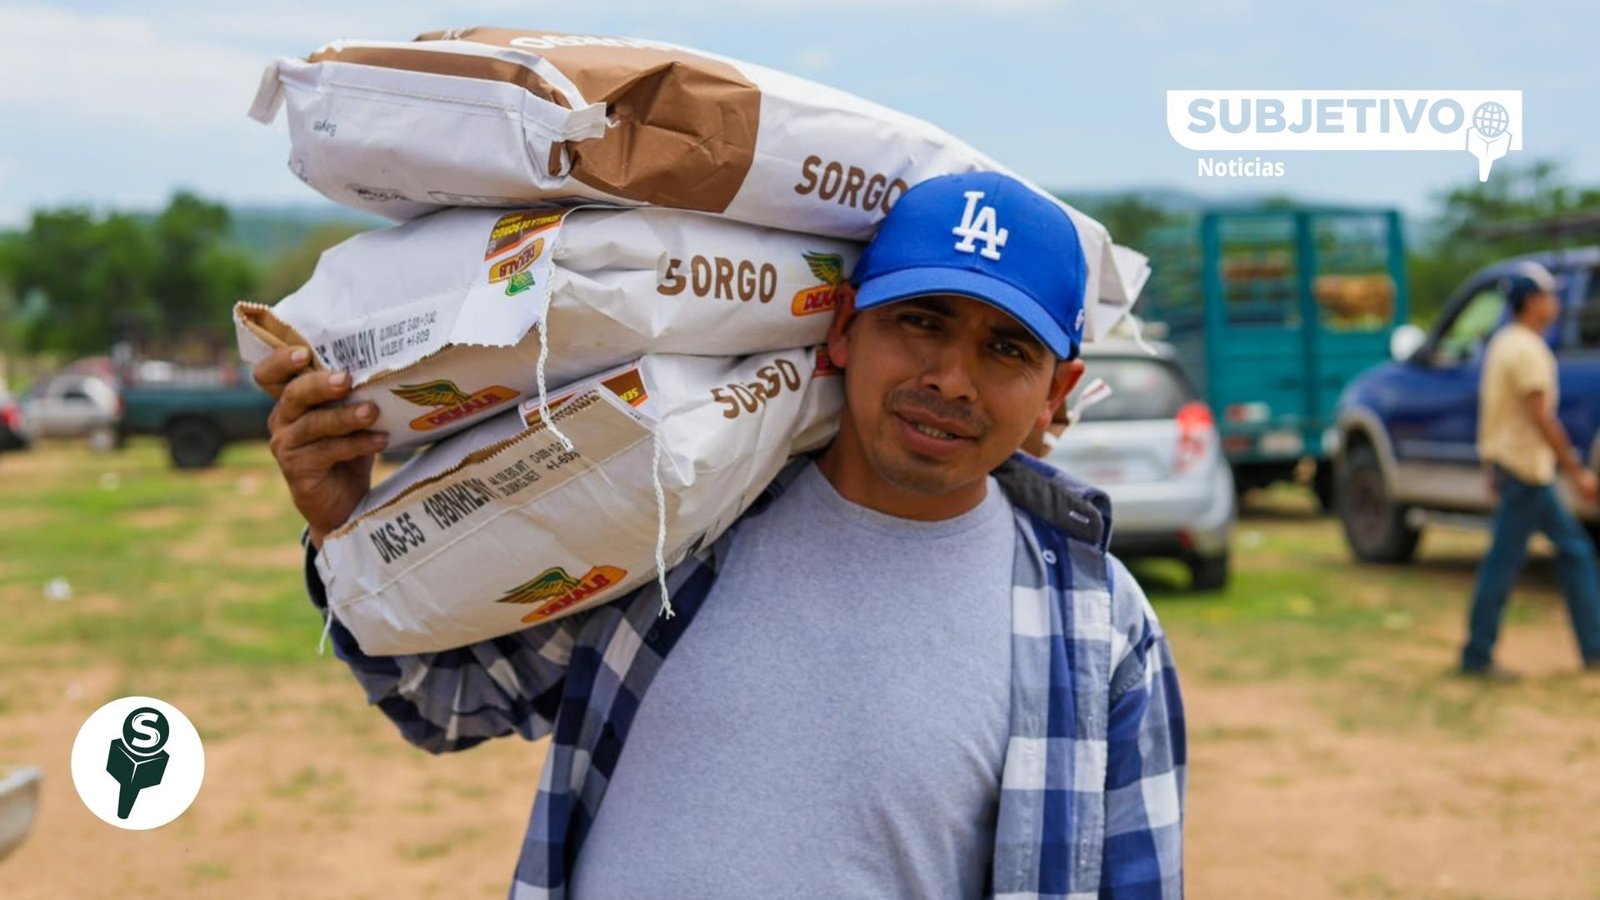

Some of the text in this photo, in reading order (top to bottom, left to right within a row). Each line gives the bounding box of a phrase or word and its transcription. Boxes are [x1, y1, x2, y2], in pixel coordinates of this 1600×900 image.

[794, 155, 908, 215] SORGO
[952, 191, 1009, 262] LA
[499, 245, 536, 278] DEKALB
[656, 255, 778, 304] SORGO
[369, 512, 427, 564] DKS-55
